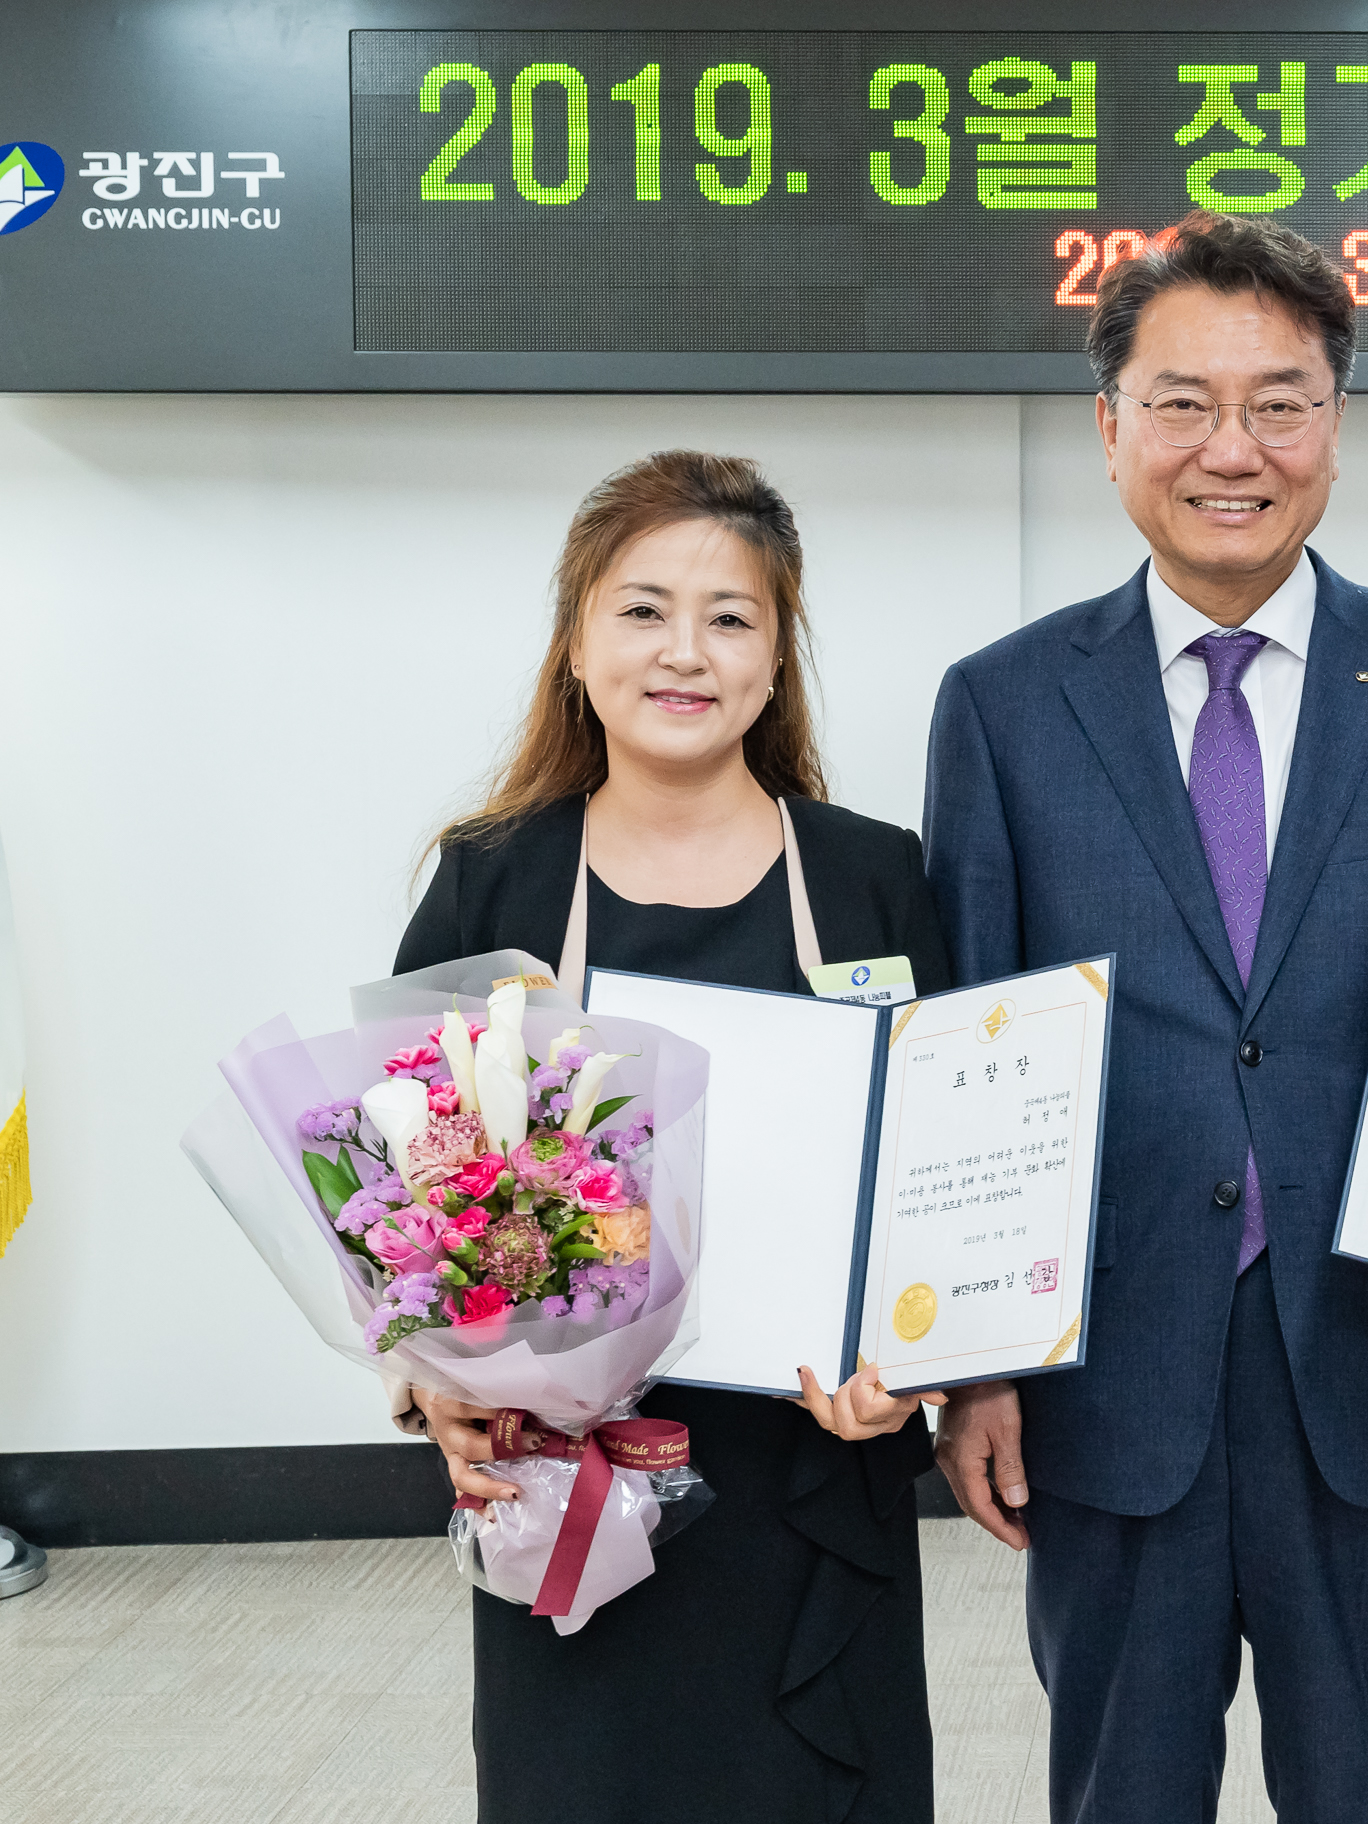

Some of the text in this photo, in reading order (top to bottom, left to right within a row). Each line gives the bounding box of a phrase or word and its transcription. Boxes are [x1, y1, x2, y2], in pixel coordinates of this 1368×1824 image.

[420, 63, 807, 205] 2019.
[870, 57, 1097, 210] 3월
[79, 150, 286, 201] 광진구
[82, 207, 281, 231] GWANGJIN-GU
[957, 1154, 981, 1168] 지역의
[988, 1148, 1013, 1162] 어려운
[1019, 1141, 1045, 1155] 이웃을
[1051, 1137, 1068, 1149] 위한
[959, 1175, 975, 1189] 통해
[981, 1171, 997, 1183] 재능
[1002, 1167, 1018, 1179] 기부
[1023, 1163, 1039, 1176] 문화
[897, 1206, 919, 1219] 기여한
[922, 1203, 937, 1216] 공이
[939, 1199, 963, 1212] 크므로
[966, 1194, 981, 1206] 이에
[951, 1279, 1000, 1298] 광진구청장
[621, 1442, 649, 1456] Made
